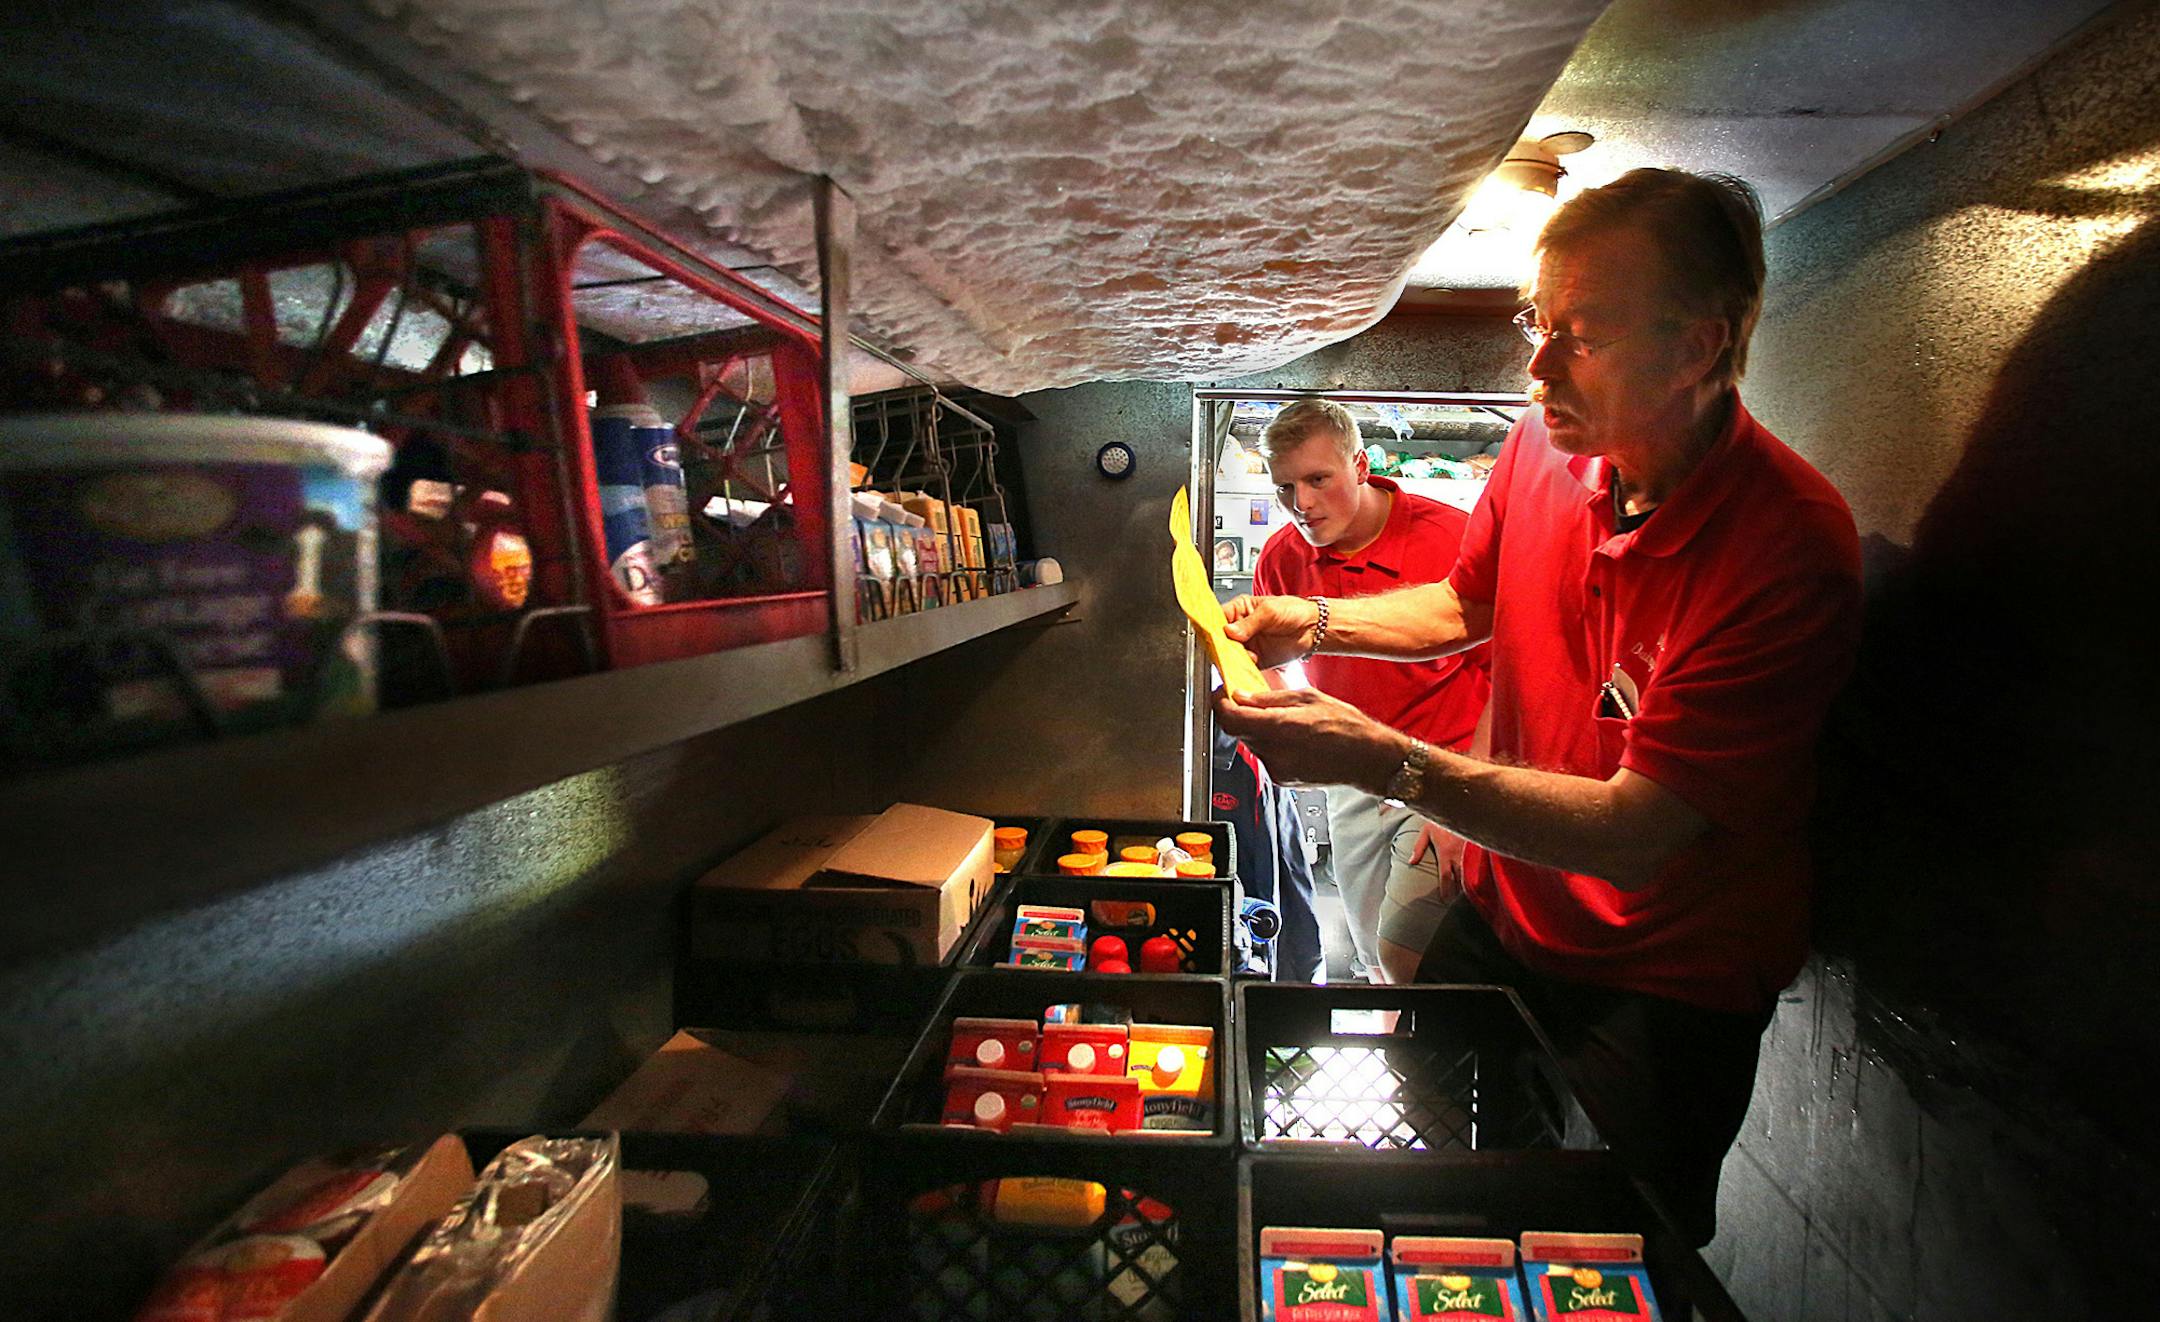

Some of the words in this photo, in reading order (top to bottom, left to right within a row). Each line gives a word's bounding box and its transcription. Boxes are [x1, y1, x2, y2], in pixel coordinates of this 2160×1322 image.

[1298, 1280, 1349, 1304] Select
[1433, 1289, 1483, 1312] Select
[1569, 1287, 1617, 1310] Select
